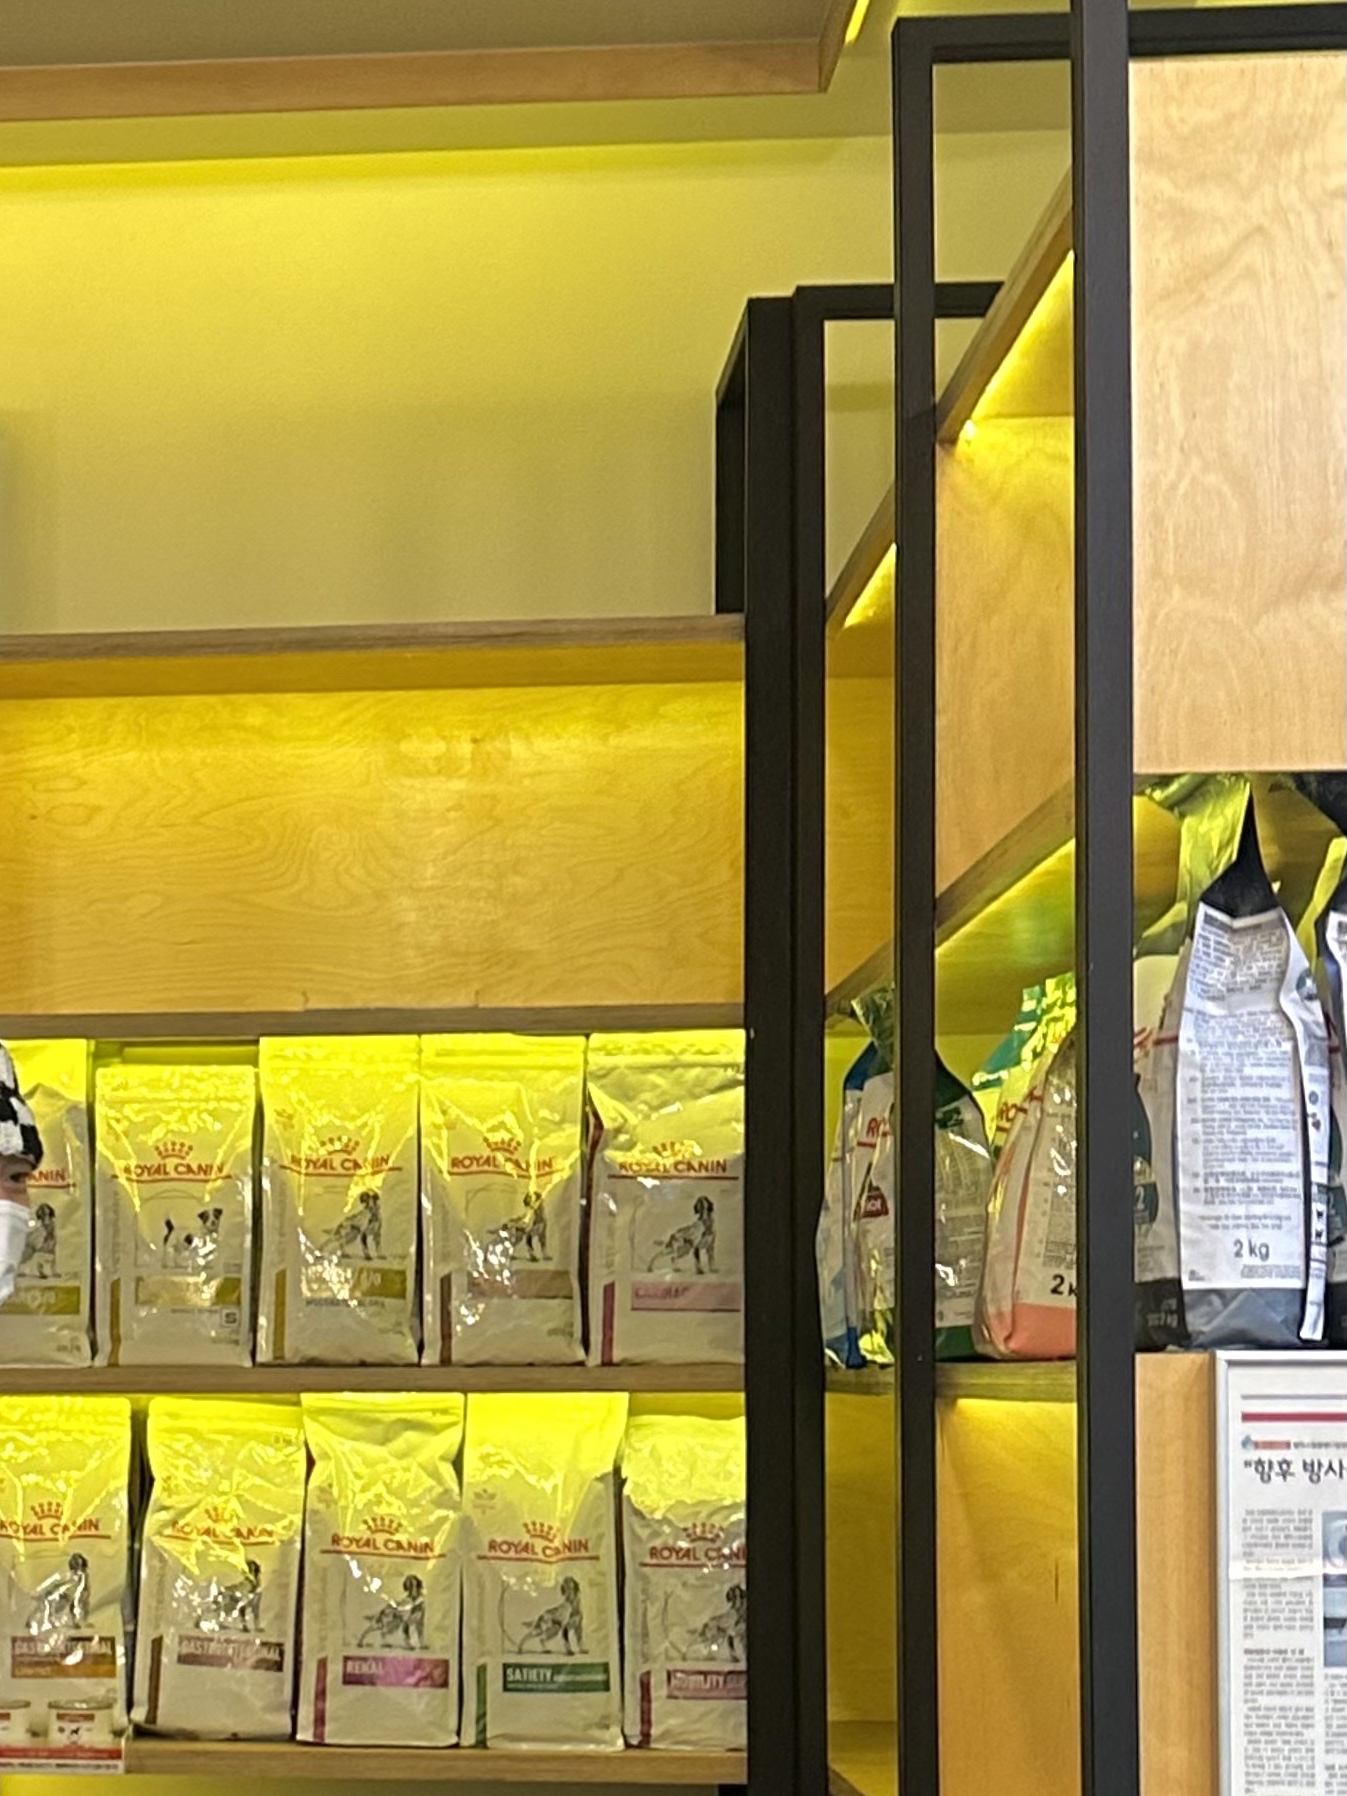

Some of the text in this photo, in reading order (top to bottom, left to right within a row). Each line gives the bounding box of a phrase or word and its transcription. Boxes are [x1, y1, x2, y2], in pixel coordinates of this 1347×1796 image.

[451, 1155, 500, 1170] ROYAL
[673, 1160, 727, 1173] CANIN
[28, 1169, 66, 1182] ANIN
[1233, 1238, 1270, 1262] 2 kg
[1049, 1273, 1065, 1295] 2
[332, 1534, 434, 1553] ROYAL CANIN
[489, 1539, 589, 1558] ROYAL CANIN
[650, 1546, 747, 1561] ROYAL CANI
[506, 1668, 552, 1682] SATIETY
